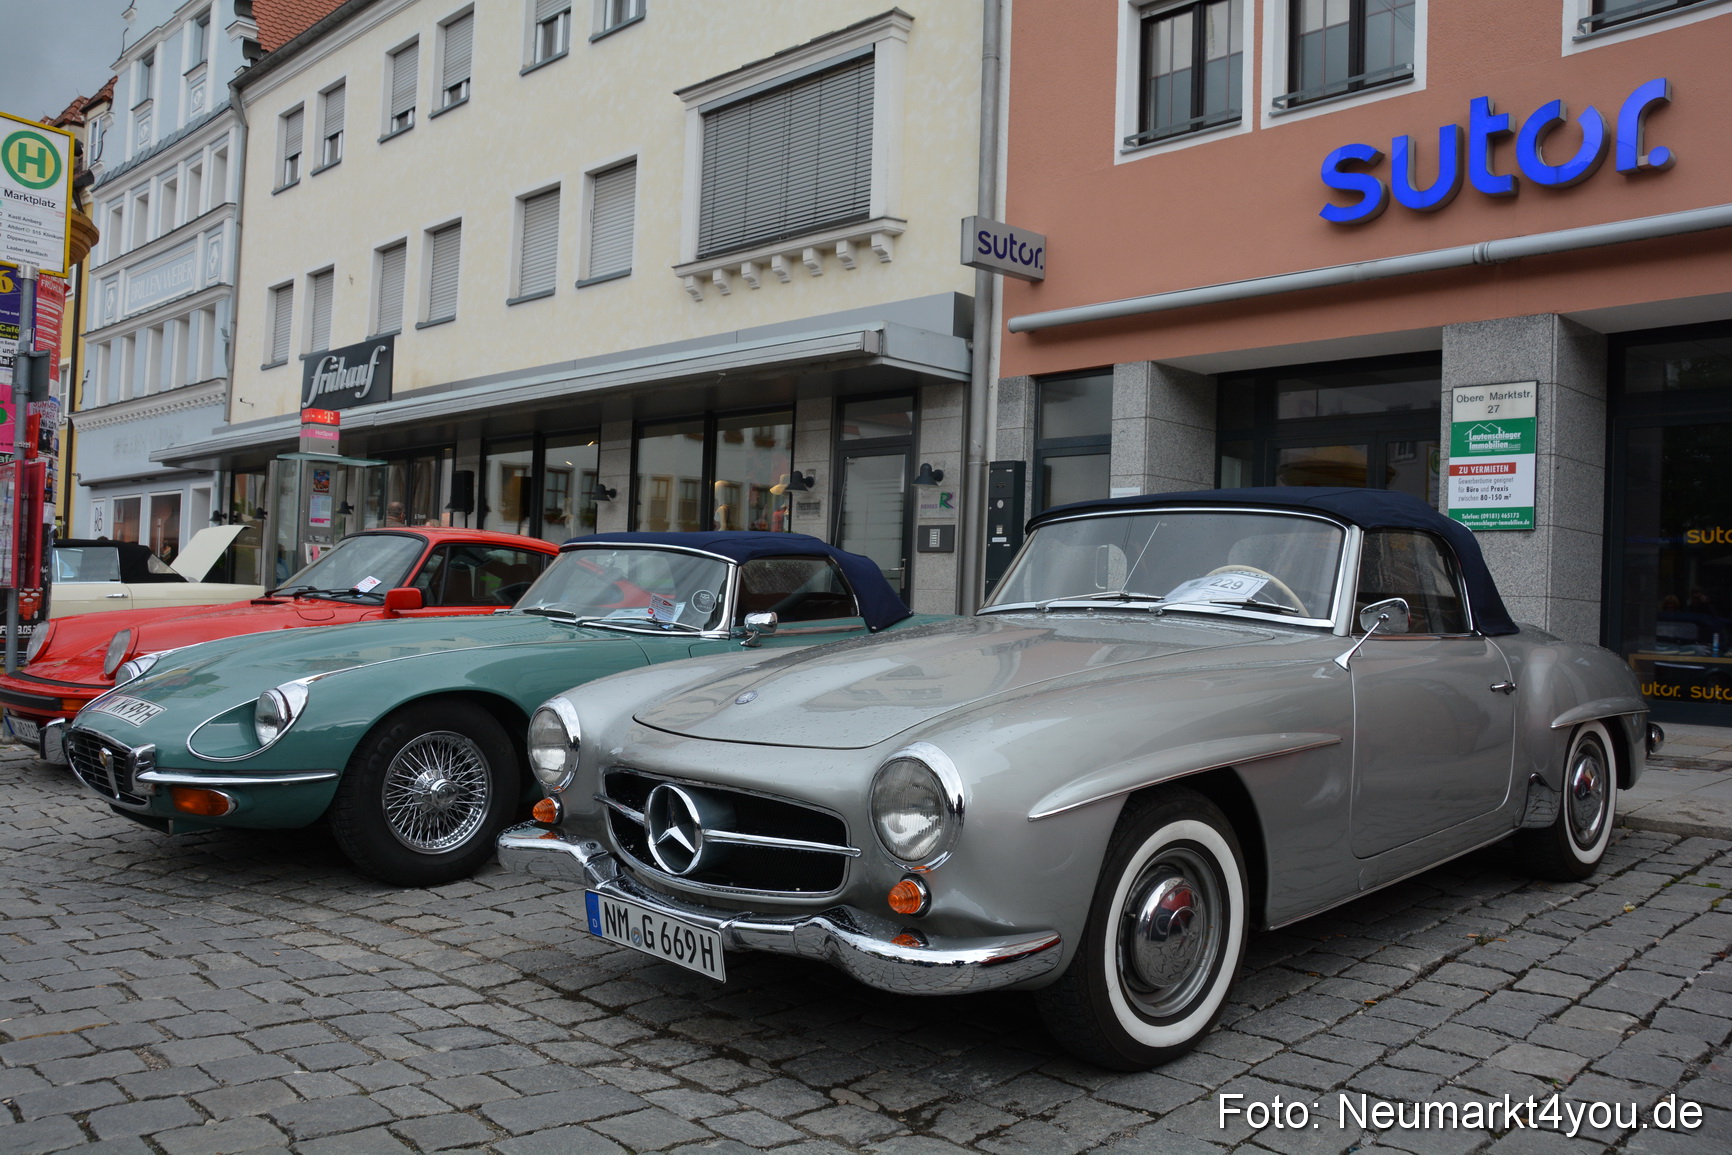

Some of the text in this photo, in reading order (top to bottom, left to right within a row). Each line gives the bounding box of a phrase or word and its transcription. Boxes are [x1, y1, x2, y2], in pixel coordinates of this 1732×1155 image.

[1318, 77, 1677, 225] sutor.
[18, 142, 47, 179] H
[4, 189, 56, 208] Marktplatz
[8, 213, 42, 226] Kastl Amberg
[8, 224, 25, 232] Altdorf
[43, 232, 64, 240] Klinikum
[977, 230, 1044, 271] sutor.
[2, 346, 14, 354] und
[302, 345, 386, 409] frühauf
[1456, 390, 1534, 404] Obere Marktstr.
[1487, 404, 1500, 414] 27
[1468, 427, 1522, 440] Lautenschlager
[1469, 440, 1509, 451] Immobilien
[1458, 464, 1509, 475] ZU VERMIETEN
[1458, 477, 1514, 486] Gewerberäume geeignet
[1466, 485, 1480, 493] Büro
[1458, 494, 1479, 502] zwischen
[1480, 493, 1502, 501] 80-150
[1209, 578, 1244, 590] 229
[1641, 681, 1681, 698] utor.
[604, 901, 630, 941] NM
[642, 914, 655, 950] G
[660, 921, 715, 972] 669H
